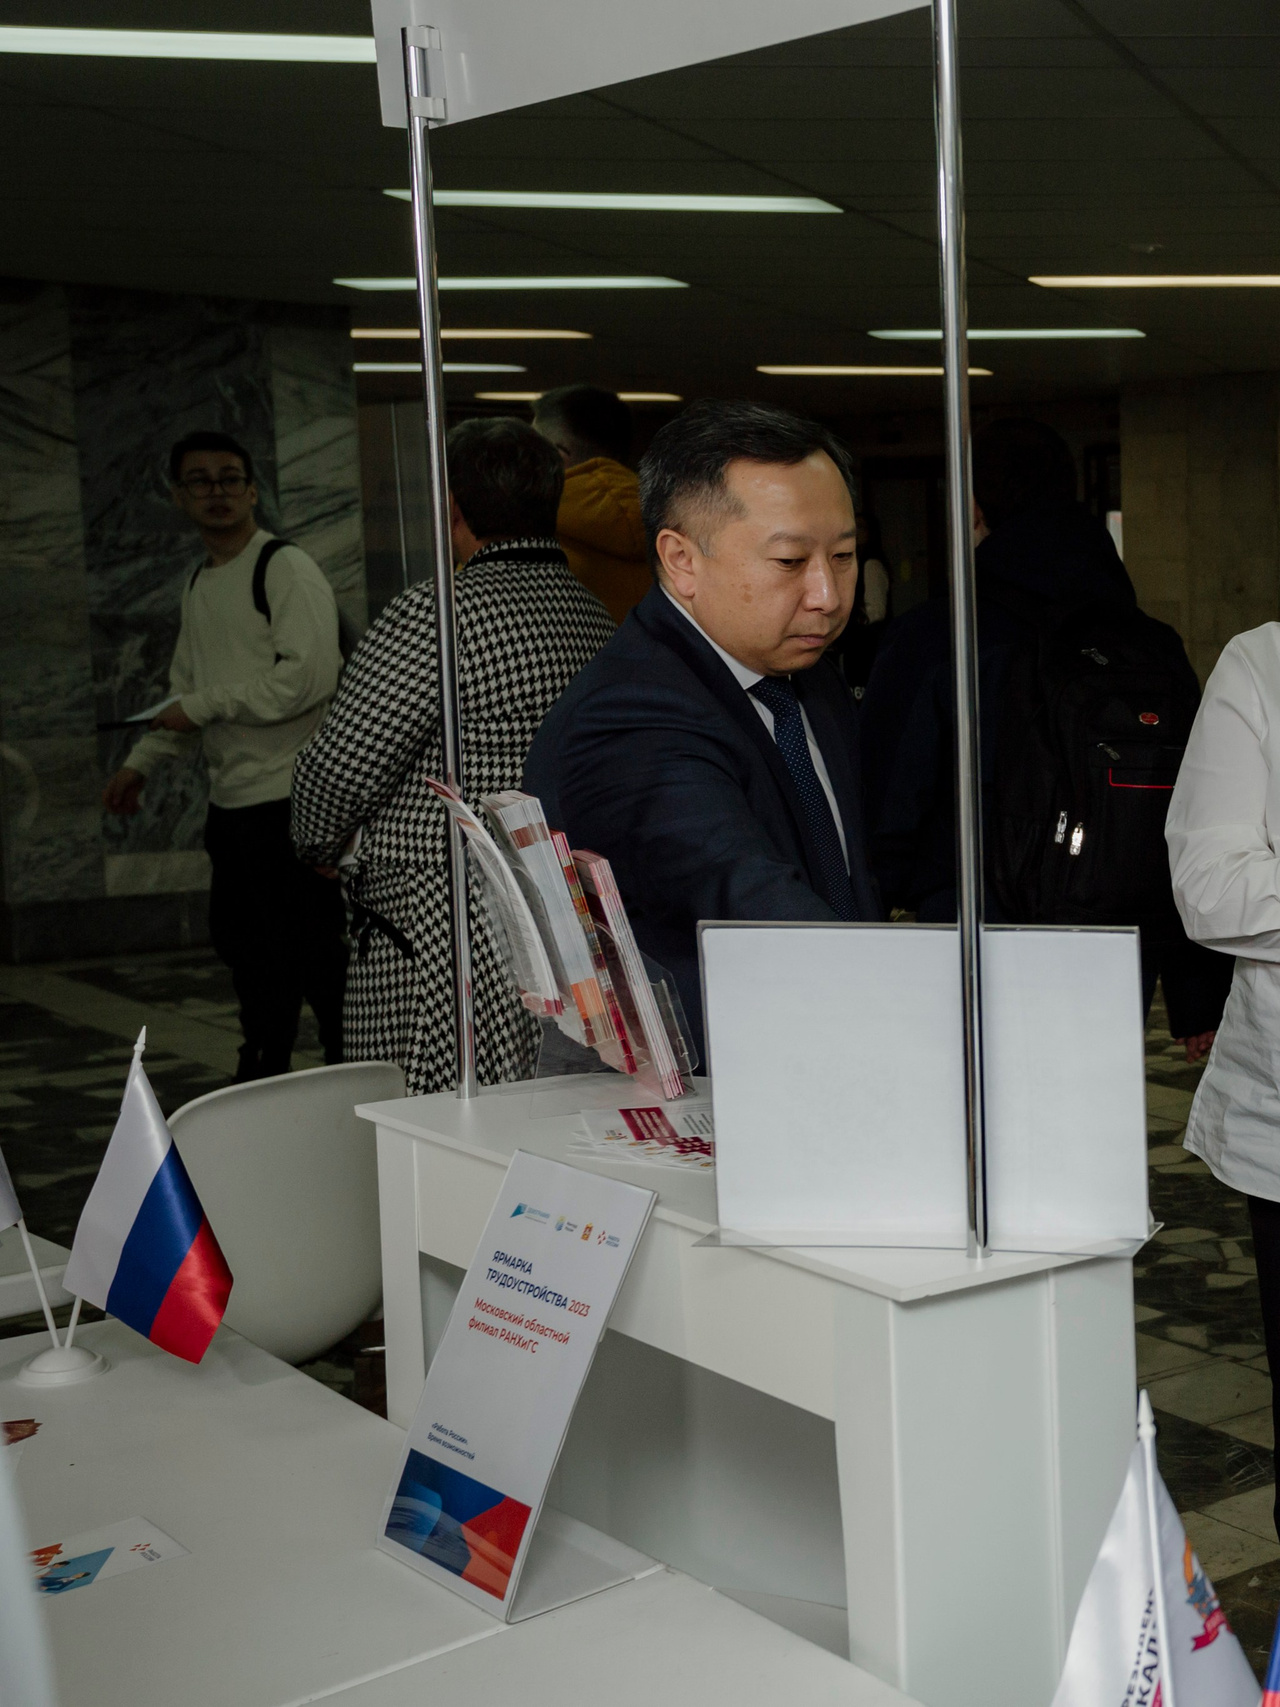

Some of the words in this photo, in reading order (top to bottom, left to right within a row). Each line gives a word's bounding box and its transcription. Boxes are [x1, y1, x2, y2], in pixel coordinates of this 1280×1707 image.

[492, 1250, 533, 1275] ЯРМАРКА
[486, 1267, 568, 1309] ТРУДОУСТРОЙСТВА
[568, 1299, 591, 1317] 2023
[468, 1316, 499, 1338] филиал
[499, 1328, 539, 1353] РАНХиГС
[474, 1297, 525, 1327] Московский
[524, 1318, 571, 1345] областной
